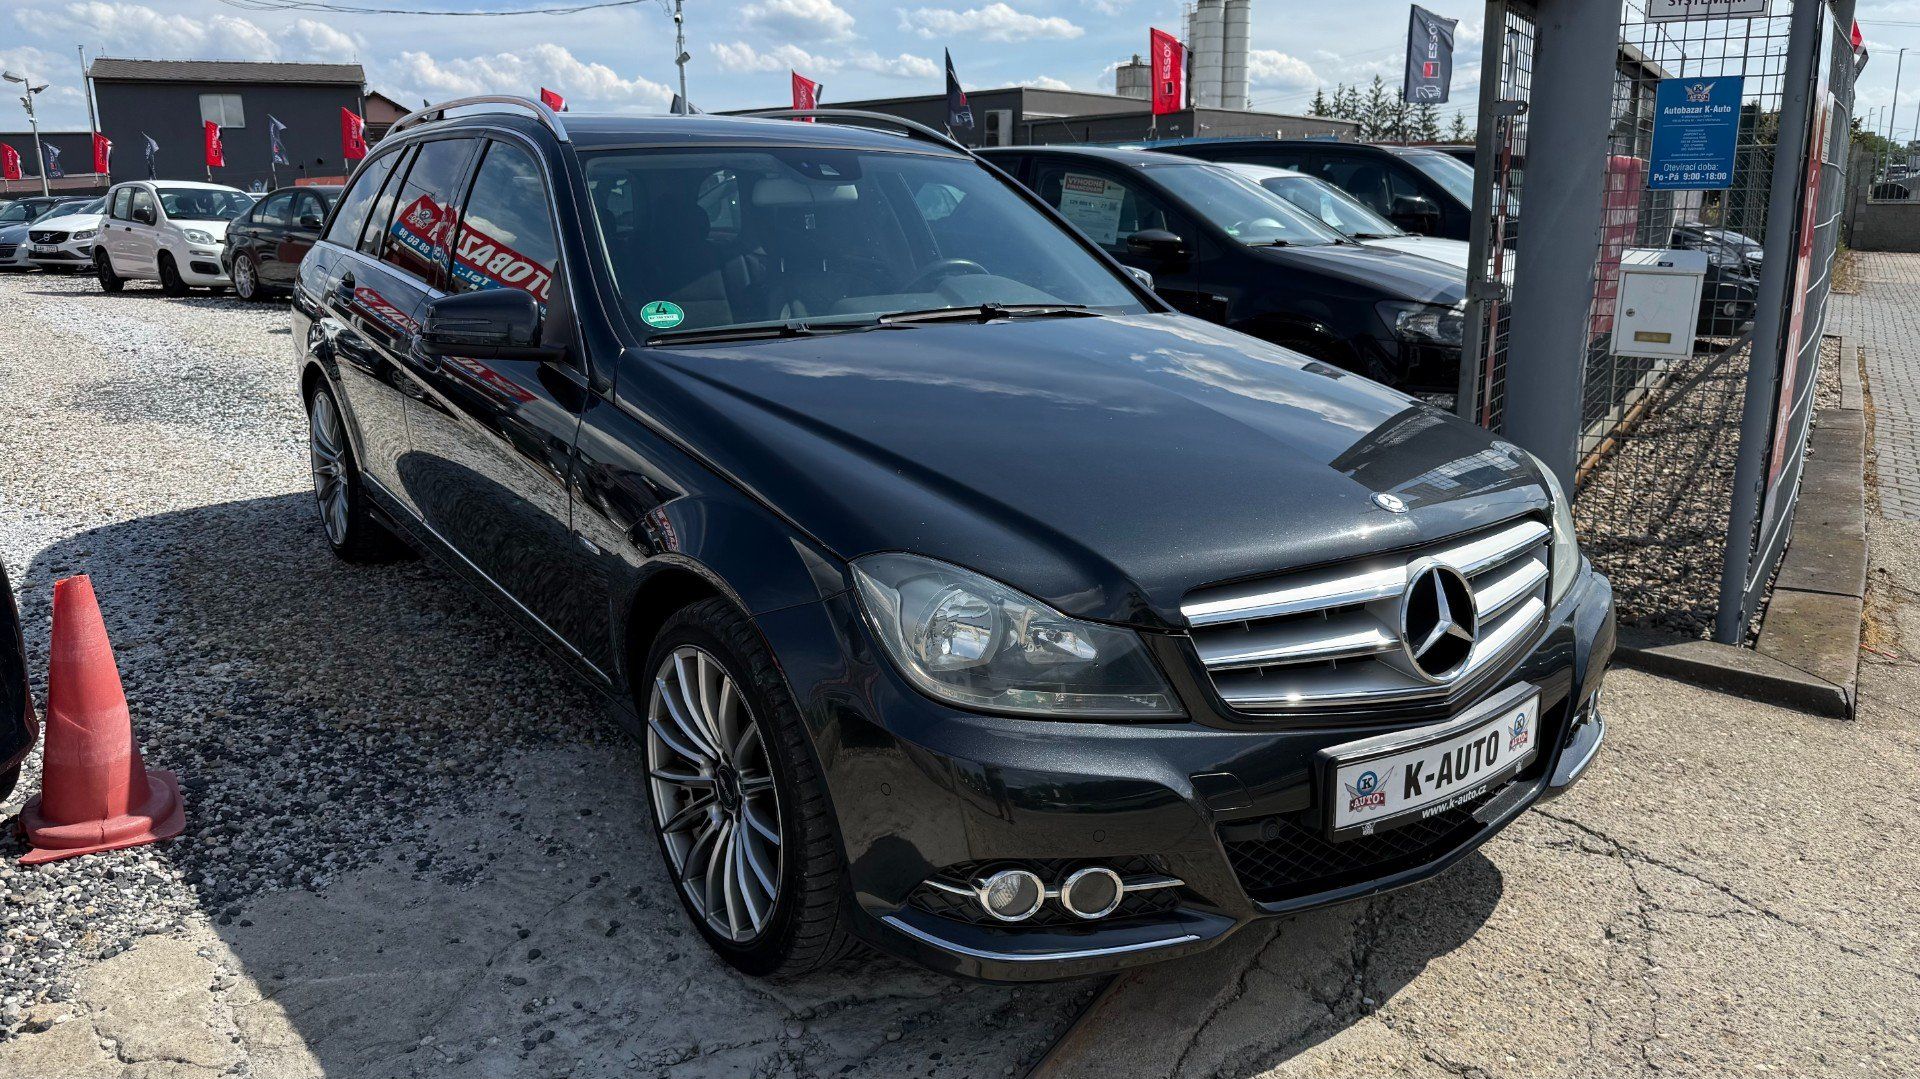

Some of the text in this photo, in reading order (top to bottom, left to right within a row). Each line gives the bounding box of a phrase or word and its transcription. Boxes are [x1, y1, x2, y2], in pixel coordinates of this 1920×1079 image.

[1163, 43, 1171, 79] ESSOX
[1664, 105, 1731, 115] Autobazar K-Auto
[1664, 163, 1719, 171] Otevírací doba:
[656, 302, 667, 314] 4
[1403, 730, 1499, 800] K-AUTO
[1421, 785, 1487, 819] www.k-auto.cz
